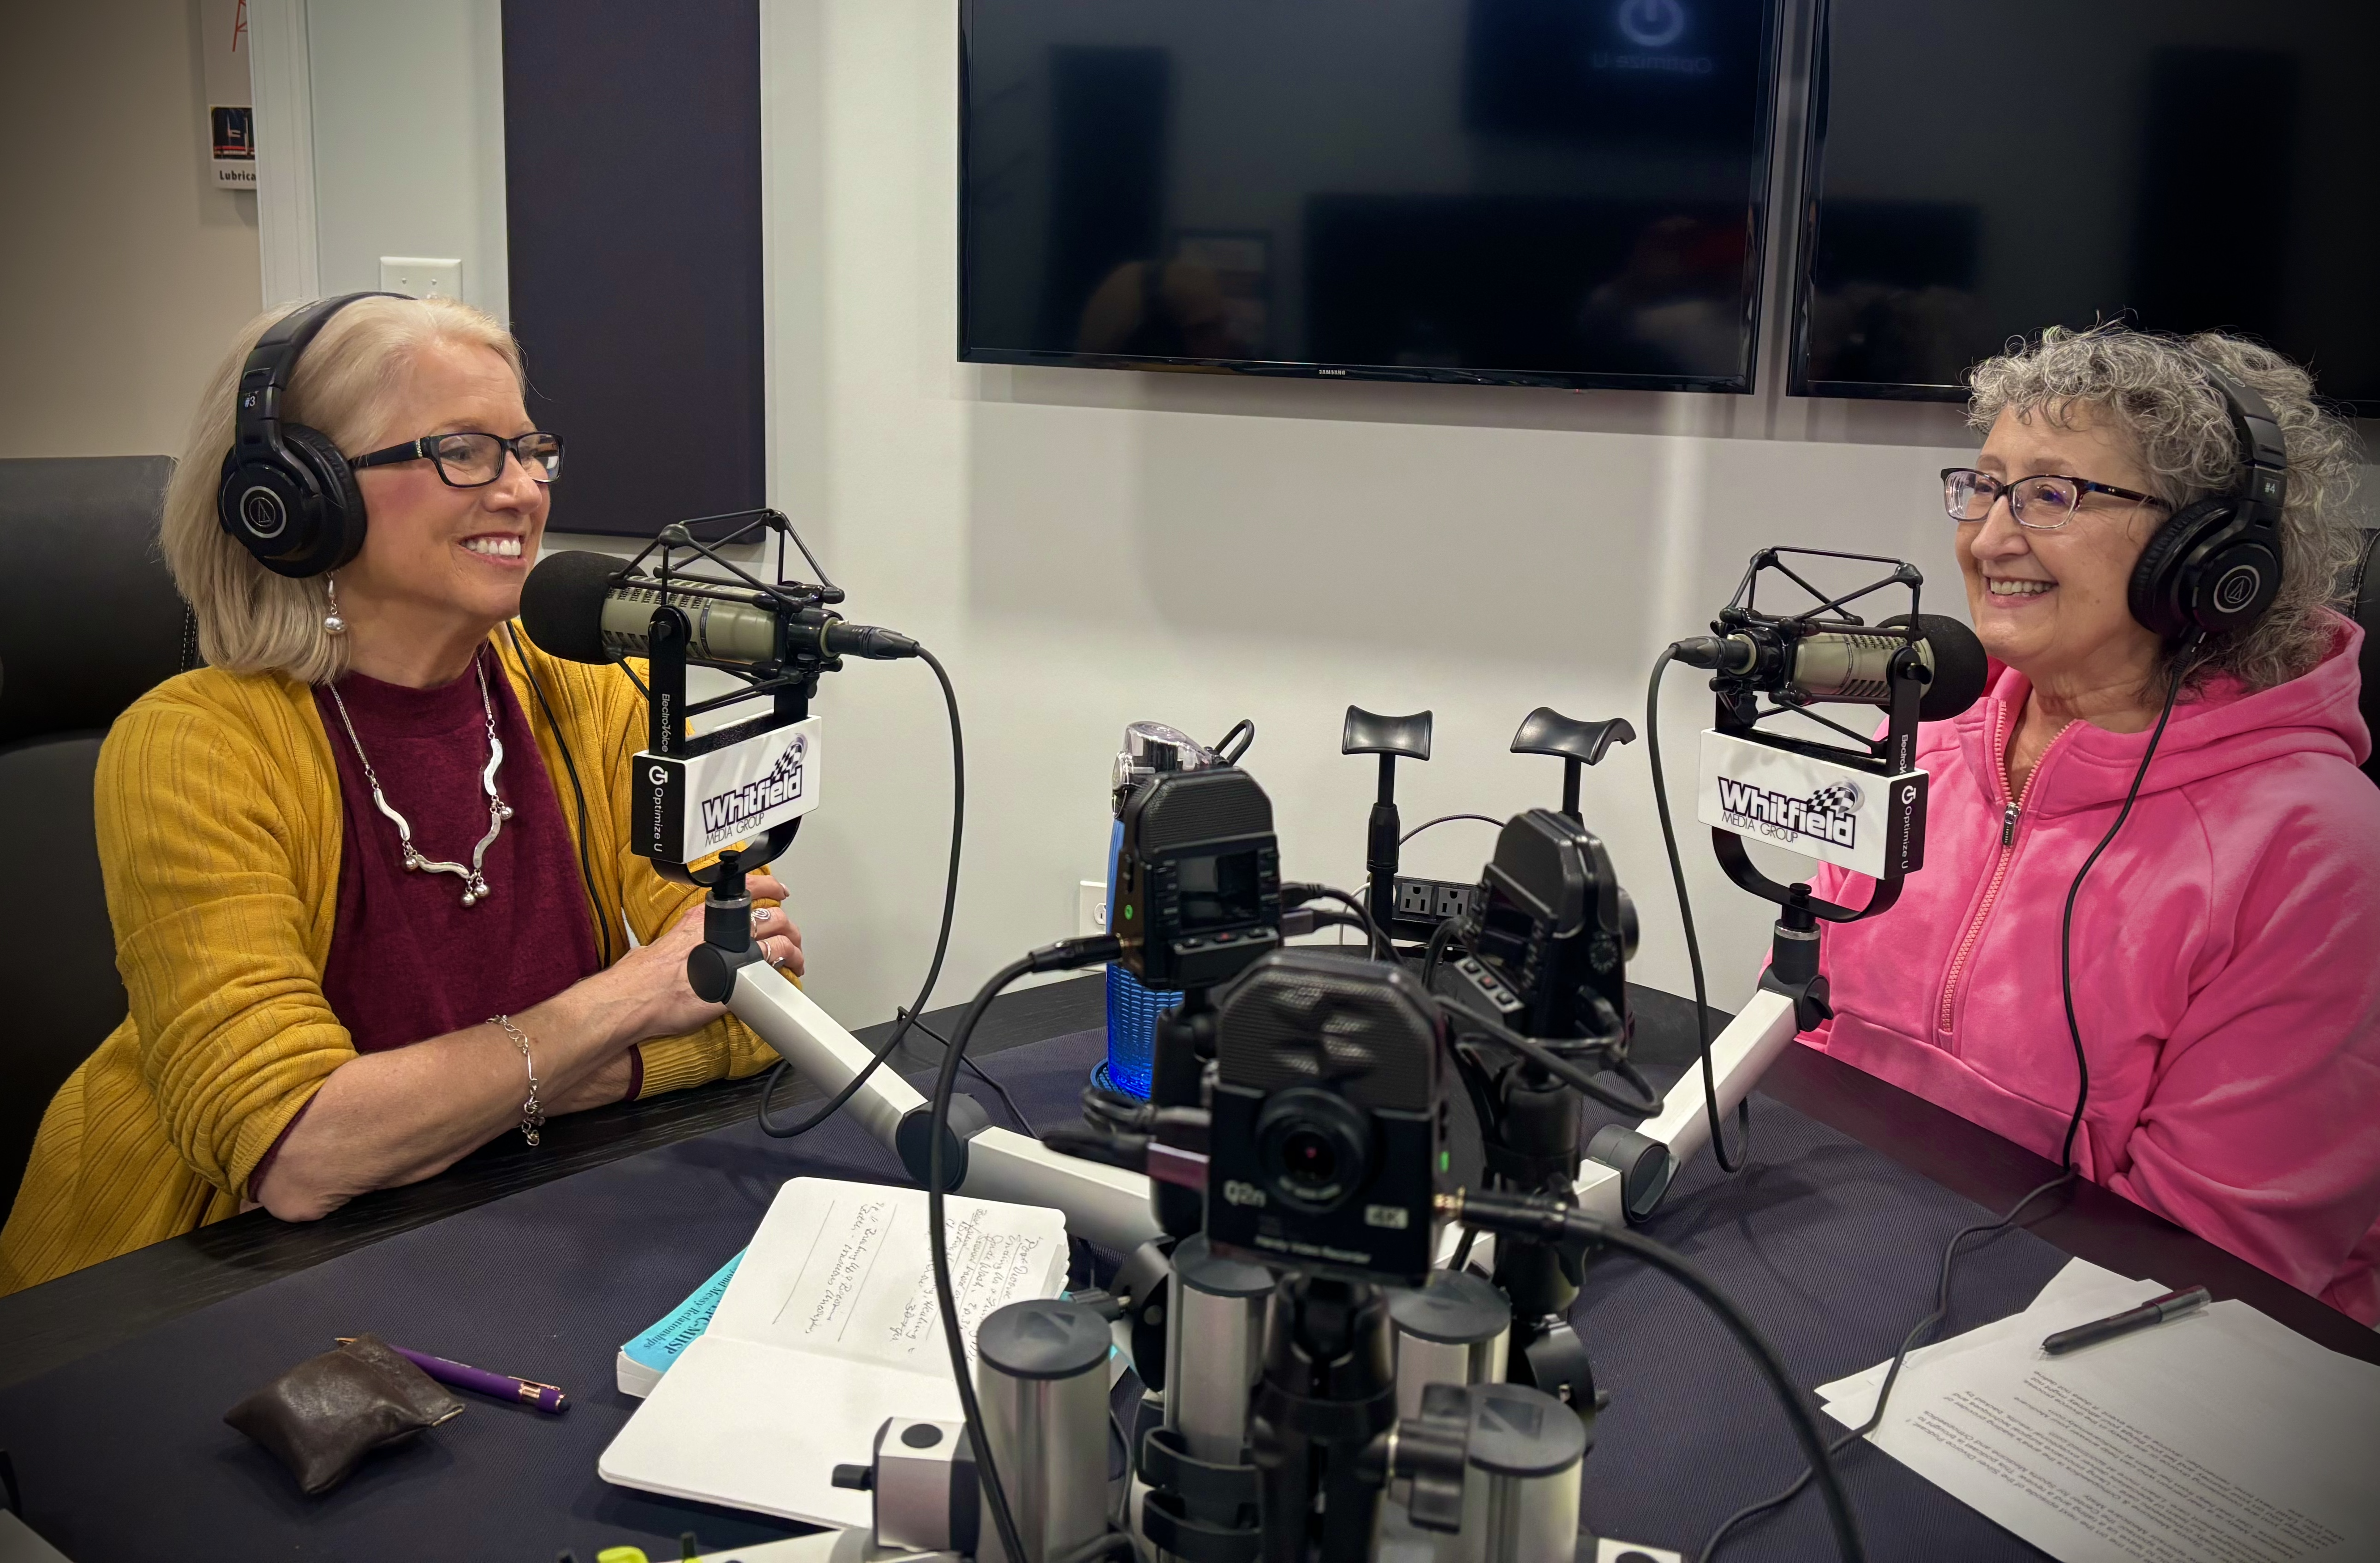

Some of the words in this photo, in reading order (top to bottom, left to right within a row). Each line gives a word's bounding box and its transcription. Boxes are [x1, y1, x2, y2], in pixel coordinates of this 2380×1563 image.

[245, 396, 256, 408] #3
[2264, 483, 2276, 495] #4
[662, 693, 671, 753] Electro-Voice
[1899, 734, 1909, 776] Electro-V
[652, 787, 664, 840] Optimize
[702, 765, 803, 834] Whitfield
[1718, 776, 1856, 850] Whitfield
[705, 826, 733, 847] MEDIA
[736, 812, 765, 834] GROUP
[1721, 811, 1755, 832] MEDIA
[1760, 823, 1798, 844] GROUP
[1901, 806, 1912, 858] Optimize
[653, 843, 662, 853] U
[1901, 860, 1909, 869] U
[693, 1286, 722, 1308] Messy
[644, 1306, 700, 1350] Relationships
